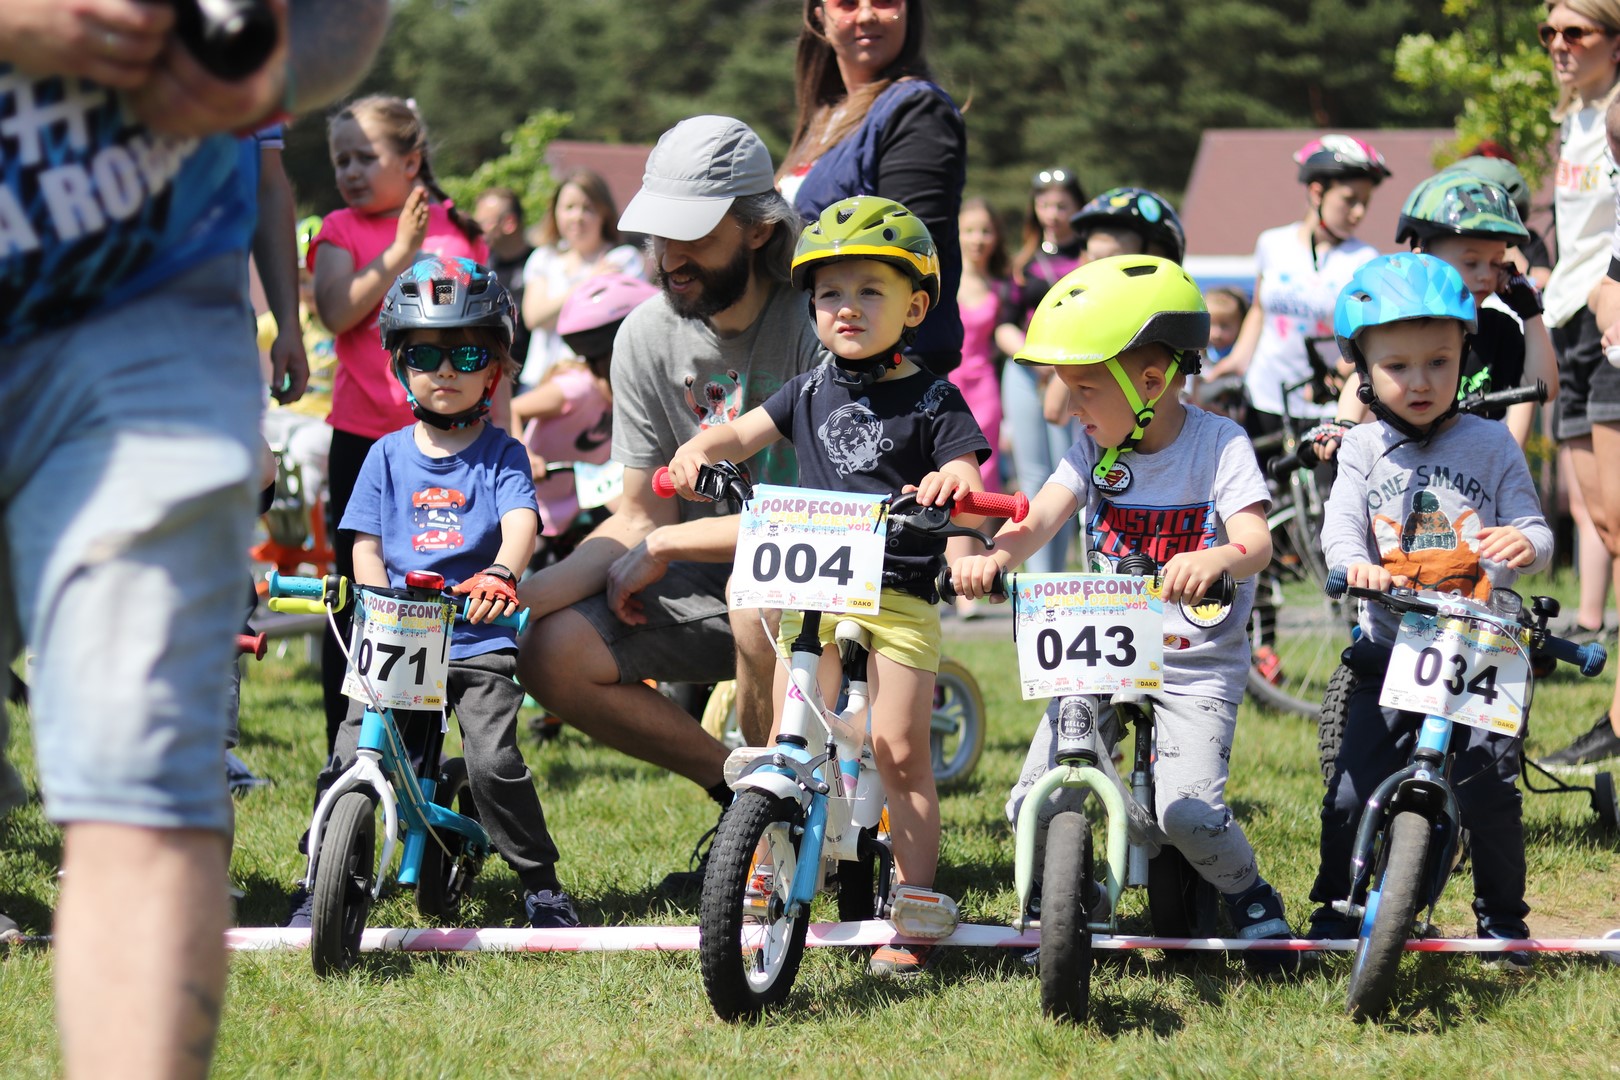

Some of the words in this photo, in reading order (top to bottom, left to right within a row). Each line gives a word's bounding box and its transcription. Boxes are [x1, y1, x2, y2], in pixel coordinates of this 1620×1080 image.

[1367, 472, 1410, 510] ONE
[1416, 465, 1492, 510] SMART
[761, 499, 872, 519] POKRĘCONY
[847, 523, 871, 532] vol2
[1097, 505, 1212, 535] JUSTICE
[752, 542, 854, 586] 004
[1034, 580, 1146, 600] POKRĘCONY
[1124, 601, 1148, 610] vol2
[427, 625, 442, 633] vol2
[1036, 625, 1137, 670] 043
[1501, 645, 1520, 655] vol2
[358, 638, 427, 685] 071
[1414, 647, 1498, 706] 034
[1064, 720, 1086, 728] HELLO
[1497, 721, 1515, 729] DAKO
